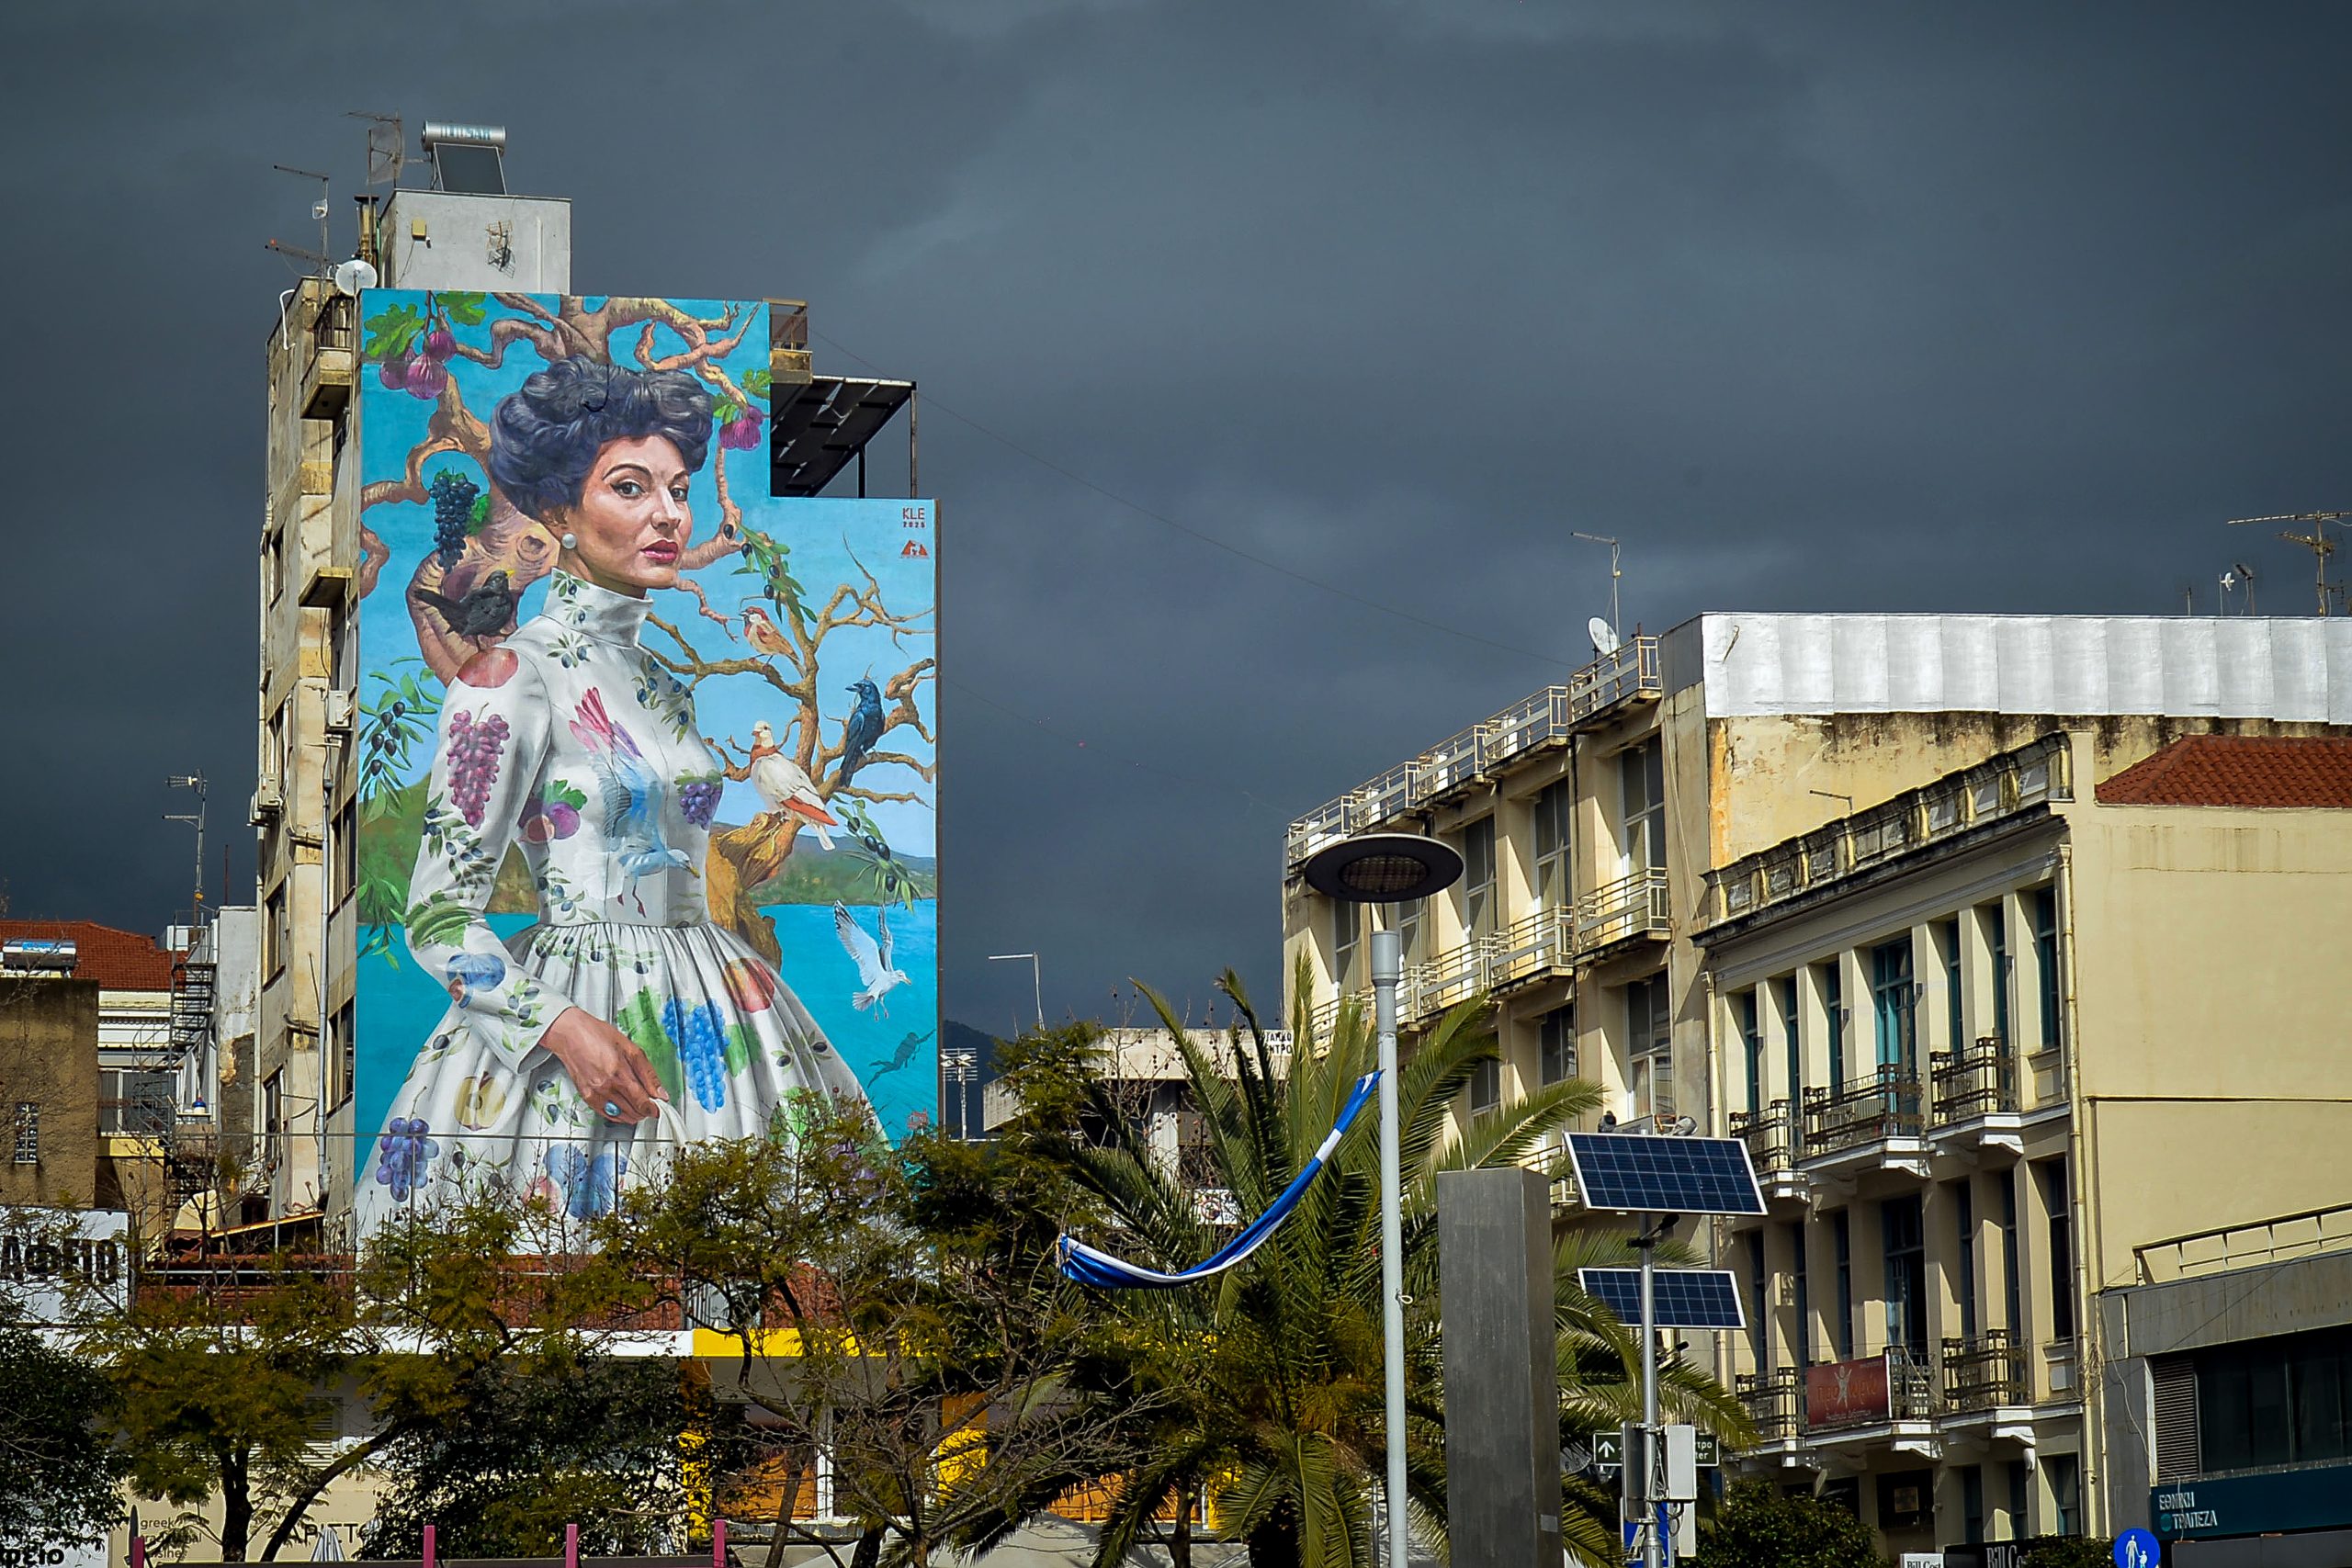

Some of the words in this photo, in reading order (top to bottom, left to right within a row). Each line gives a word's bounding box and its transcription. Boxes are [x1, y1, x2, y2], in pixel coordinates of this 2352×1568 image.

[902, 507, 925, 520] KLE
[2159, 1492, 2195, 1510] ΕΘΝΙΚΗ
[141, 1517, 175, 1530] greek
[2172, 1510, 2218, 1529] ΤΡΑΠΕΖΑ
